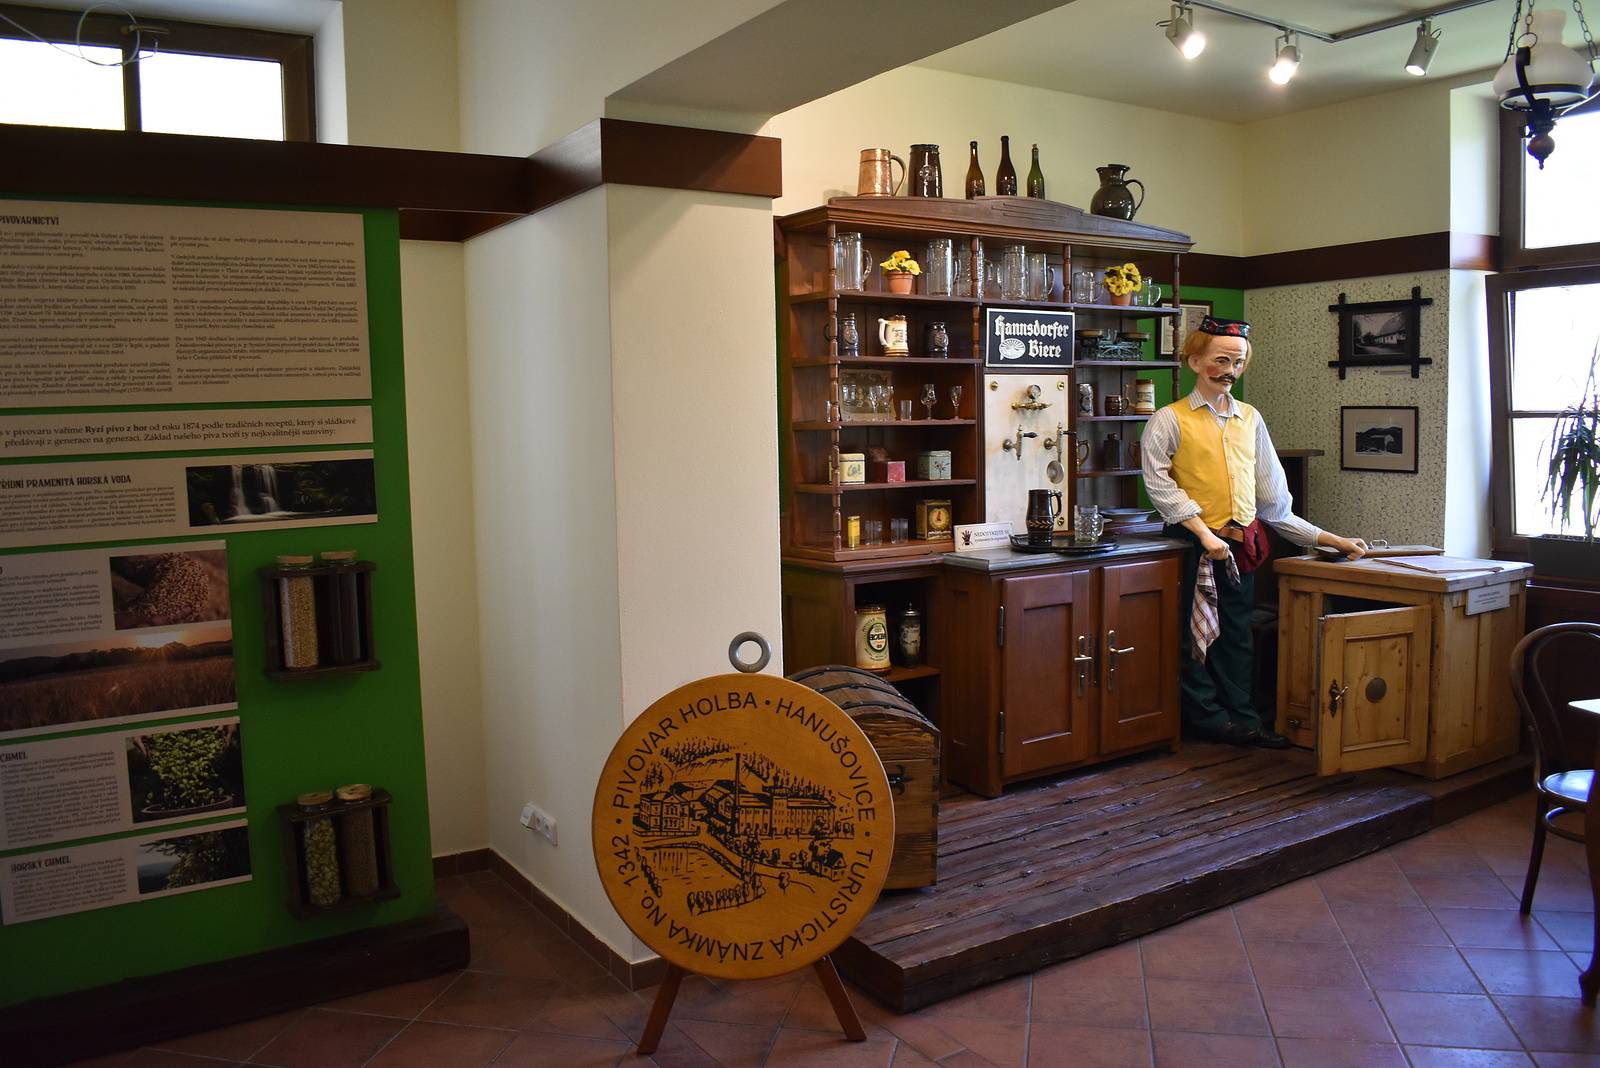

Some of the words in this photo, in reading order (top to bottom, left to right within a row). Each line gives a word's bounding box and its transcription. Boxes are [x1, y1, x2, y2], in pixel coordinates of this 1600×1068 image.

[994, 314, 1070, 346] Hannsdorfer
[1027, 339, 1062, 358] Biere
[54, 437, 91, 446] generace
[144, 431, 171, 440] Základ
[203, 430, 220, 440] piva
[241, 429, 249, 438] ty
[106, 424, 125, 434] pivo
[133, 423, 147, 432] hor
[149, 423, 160, 431] od
[162, 421, 180, 430] roku
[183, 421, 199, 430] 1874
[202, 419, 223, 430] podle
[111, 473, 132, 484] VODA
[613, 717, 679, 809] PIVOVAR
[679, 691, 758, 724] HOLBA
[775, 697, 876, 822] HANUŠOVICE
[611, 834, 639, 887] 1342
[641, 889, 668, 927] No.
[770, 848, 874, 960] TURISTICKÁ
[667, 918, 765, 964] ZNÁMKA
